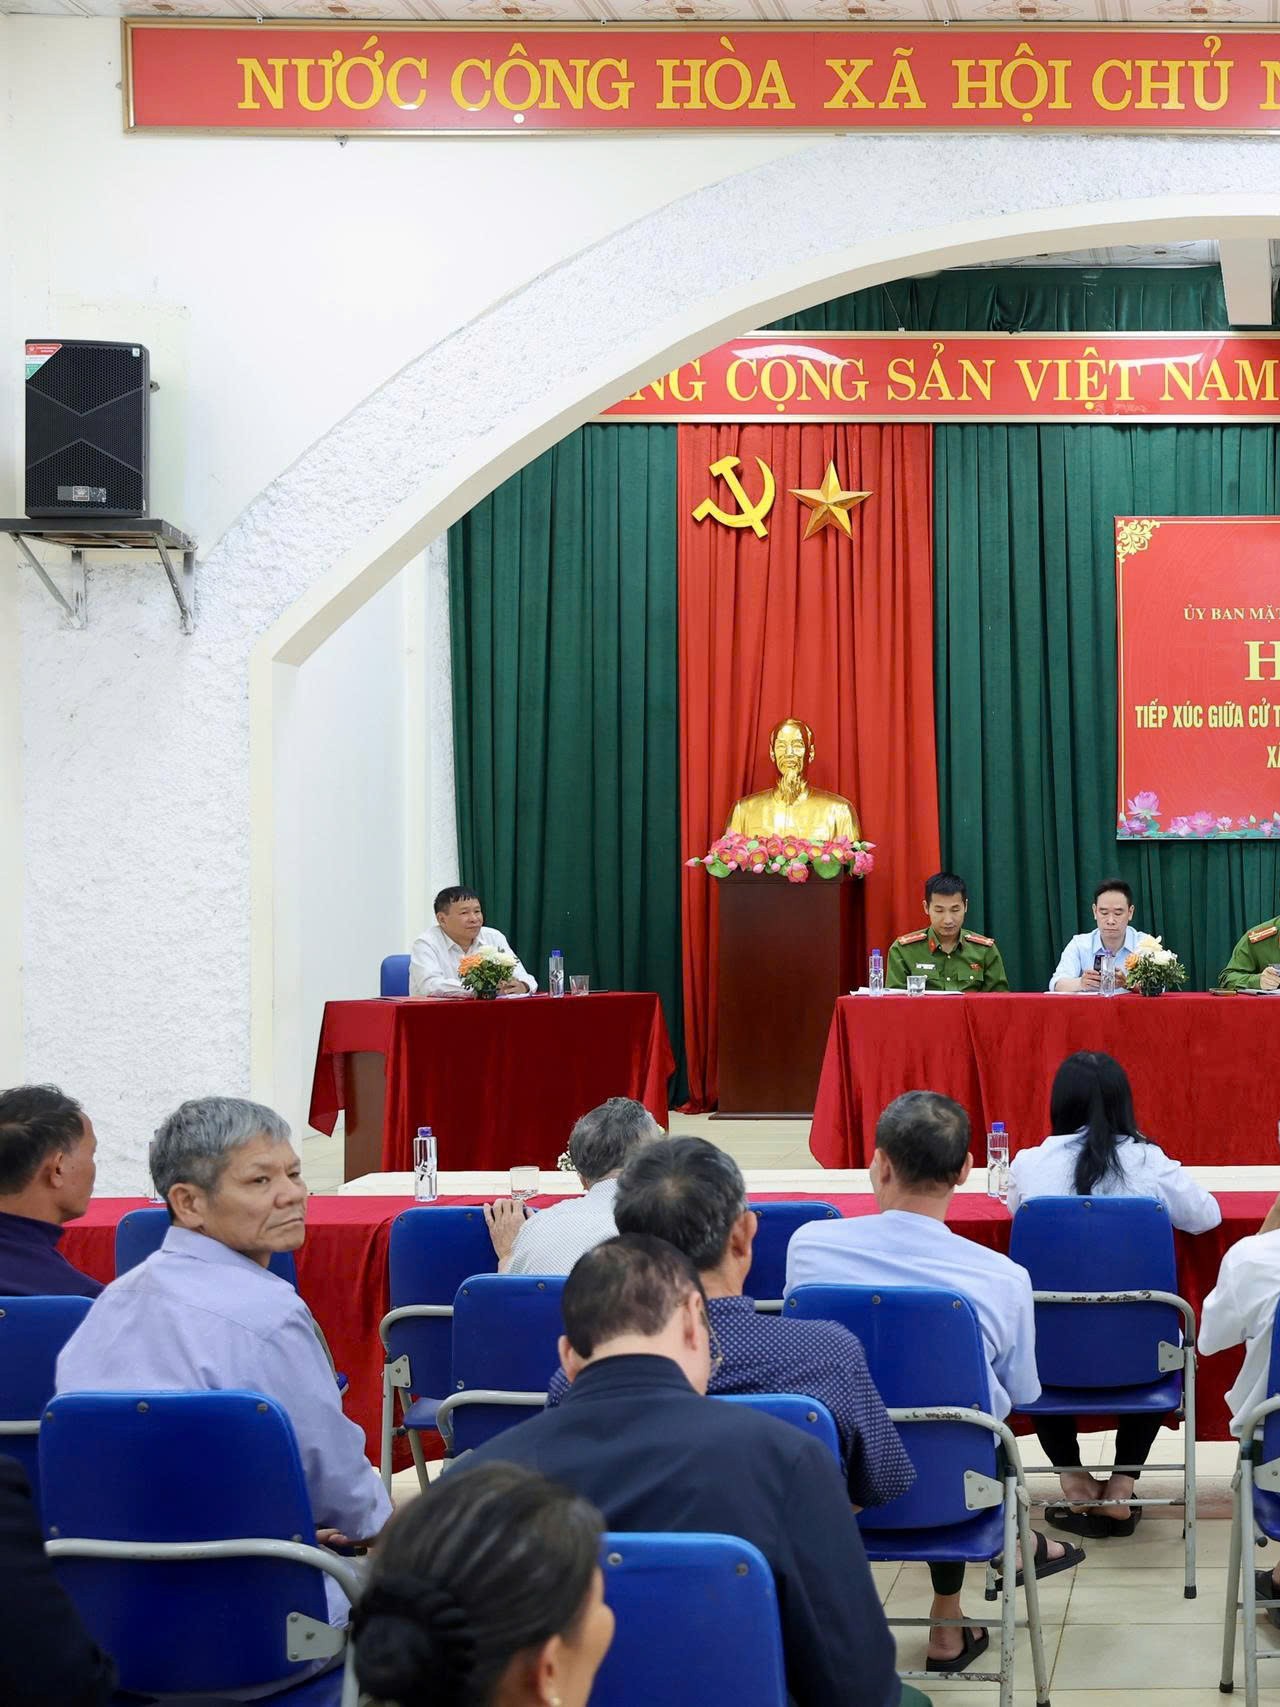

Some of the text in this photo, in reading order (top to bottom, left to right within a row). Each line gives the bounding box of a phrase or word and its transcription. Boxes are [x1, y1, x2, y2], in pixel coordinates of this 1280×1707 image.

[237, 35, 427, 112] NƯỚC
[451, 43, 635, 124] CỘNG
[656, 36, 796, 110] HÒA
[823, 47, 927, 109] XÃ
[952, 43, 1072, 123] HỘI
[1092, 35, 1234, 111] CHỦ
[726, 358, 869, 412] CỘNG
[887, 342, 996, 401] SẢN
[1014, 347, 1142, 411] VIỆT
[1159, 358, 1279, 401] NAM
[1184, 604, 1206, 620] ỦY
[1211, 607, 1245, 620] BAN
[1135, 698, 1168, 728] TIẾP
[1172, 701, 1203, 728] XÚC
[1208, 701, 1244, 728] GIỮA
[1248, 697, 1270, 728] CỬ
